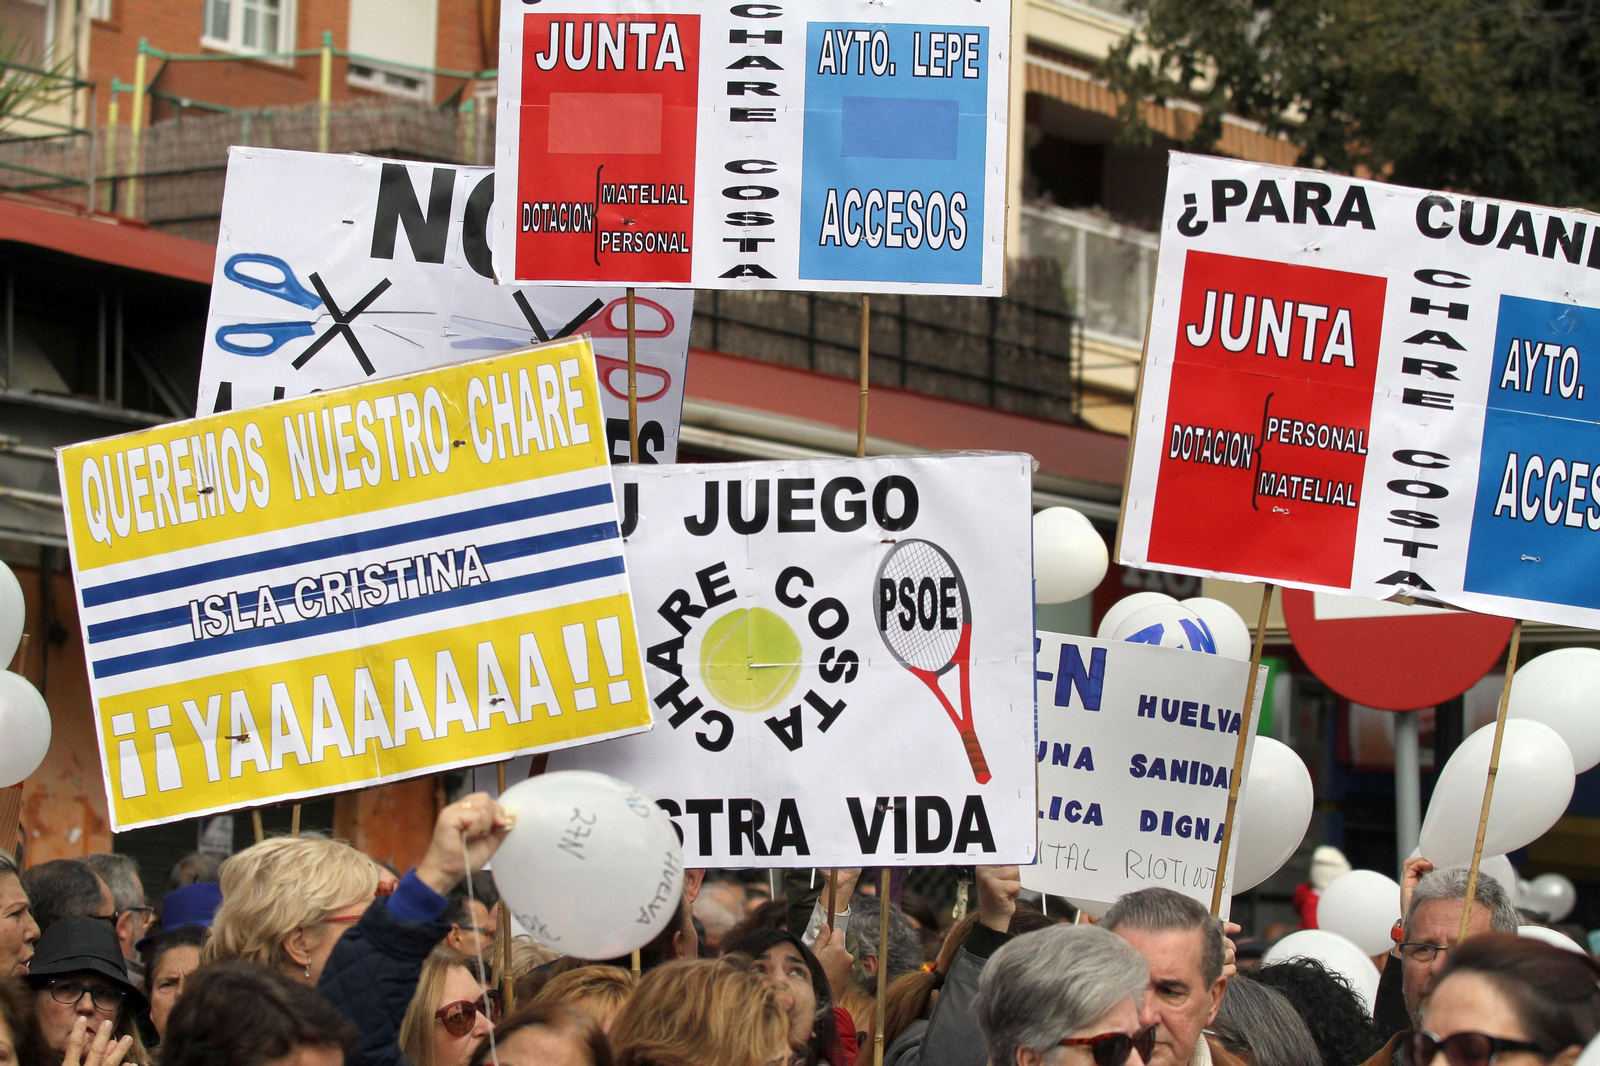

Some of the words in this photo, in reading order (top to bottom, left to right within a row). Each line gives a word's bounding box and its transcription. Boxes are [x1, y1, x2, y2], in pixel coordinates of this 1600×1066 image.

[535, 20, 686, 71] JUNTA
[725, 4, 785, 123] CHARE
[817, 29, 896, 77] AYTO.
[912, 31, 981, 79] LEPE
[521, 202, 593, 234] DOTACION
[602, 183, 690, 206] MATELIAL
[717, 159, 780, 279] COSTA
[819, 188, 968, 251] ACCESOS
[1177, 179, 1376, 237] ¿PARA
[1415, 195, 1600, 270] CUAN
[600, 230, 691, 254] PERSONAL
[1185, 289, 1356, 368] JUNTA
[1401, 268, 1472, 411] CHARE
[1499, 336, 1586, 401] AYTO.
[81, 422, 271, 548] QUEREMOS
[283, 386, 451, 502] NUESTRO
[466, 358, 591, 465] CHARE
[1169, 423, 1254, 470] DOTACION
[1265, 416, 1369, 456] PERSONAL
[683, 475, 920, 537] JUEGO
[1258, 471, 1358, 507] MATELIAL
[1375, 449, 1451, 593] COSTA
[189, 584, 285, 641] ISLA
[293, 544, 491, 621] CRISTINA
[879, 576, 960, 632] PSOE
[647, 561, 738, 752] CHARE
[764, 565, 859, 752] COSTA
[1035, 637, 1107, 712] -N
[1137, 694, 1241, 736] HUELVA
[846, 794, 997, 855] VIDA
[1038, 796, 1103, 826] ICA
[636, 851, 681, 926] HUELVA
[1125, 849, 1227, 890] RIOTINT
